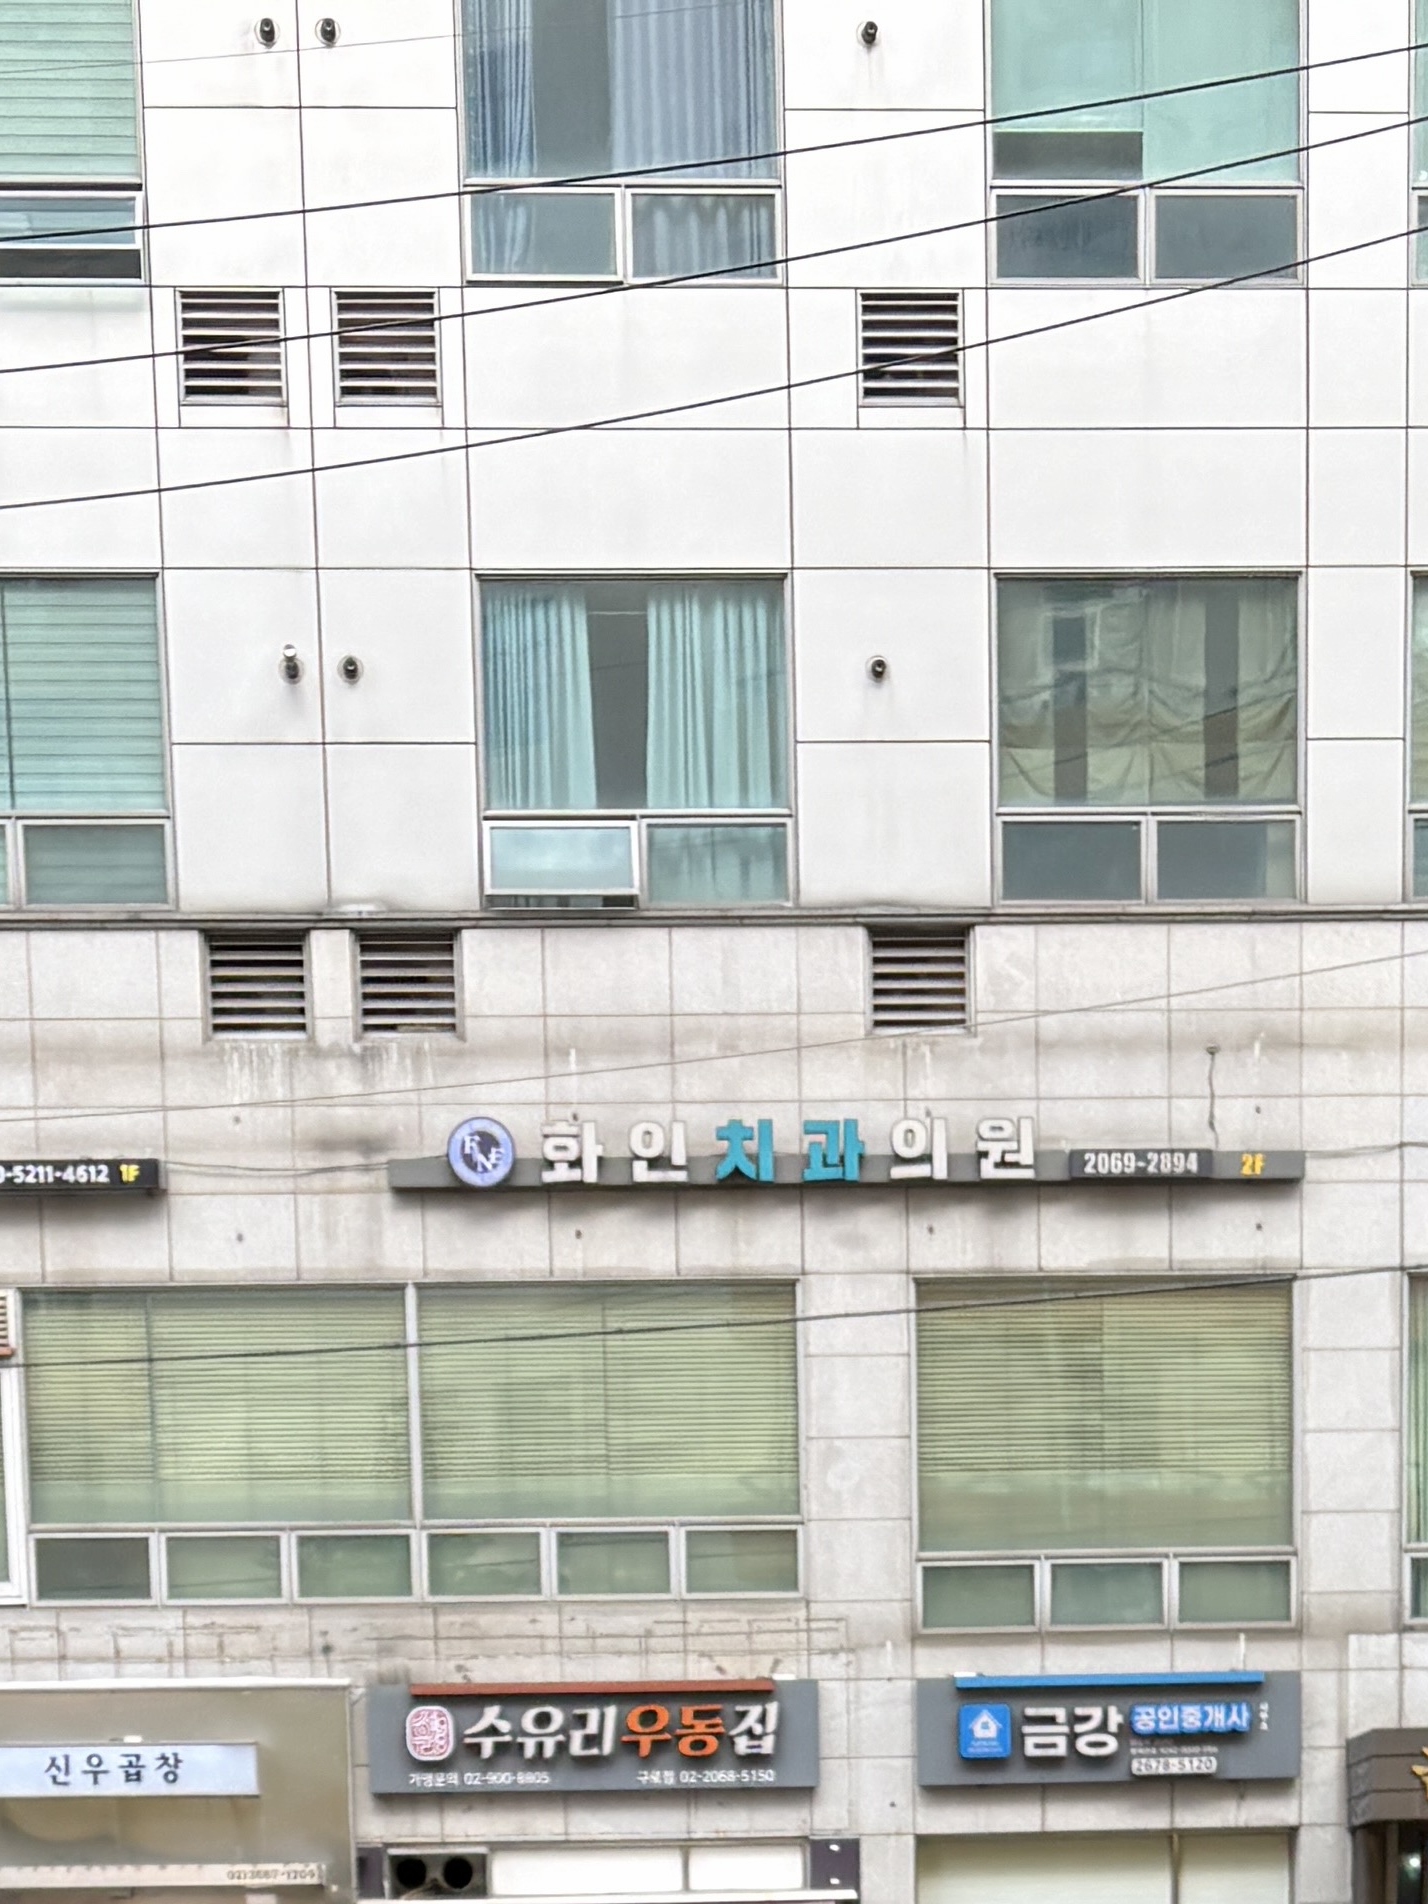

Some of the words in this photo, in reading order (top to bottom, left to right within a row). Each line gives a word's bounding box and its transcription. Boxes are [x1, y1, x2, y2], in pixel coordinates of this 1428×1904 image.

[1083, 1149, 1199, 1177] 2069-2894
[1239, 1153, 1265, 1177] 2F
[462, 1700, 779, 1760] 수유리우동집
[1022, 1704, 1124, 1758] 금강
[1131, 1701, 1252, 1732] 공인중개사
[44, 1752, 185, 1787] 신우곱창
[1135, 1756, 1215, 1774] 2678-5120
